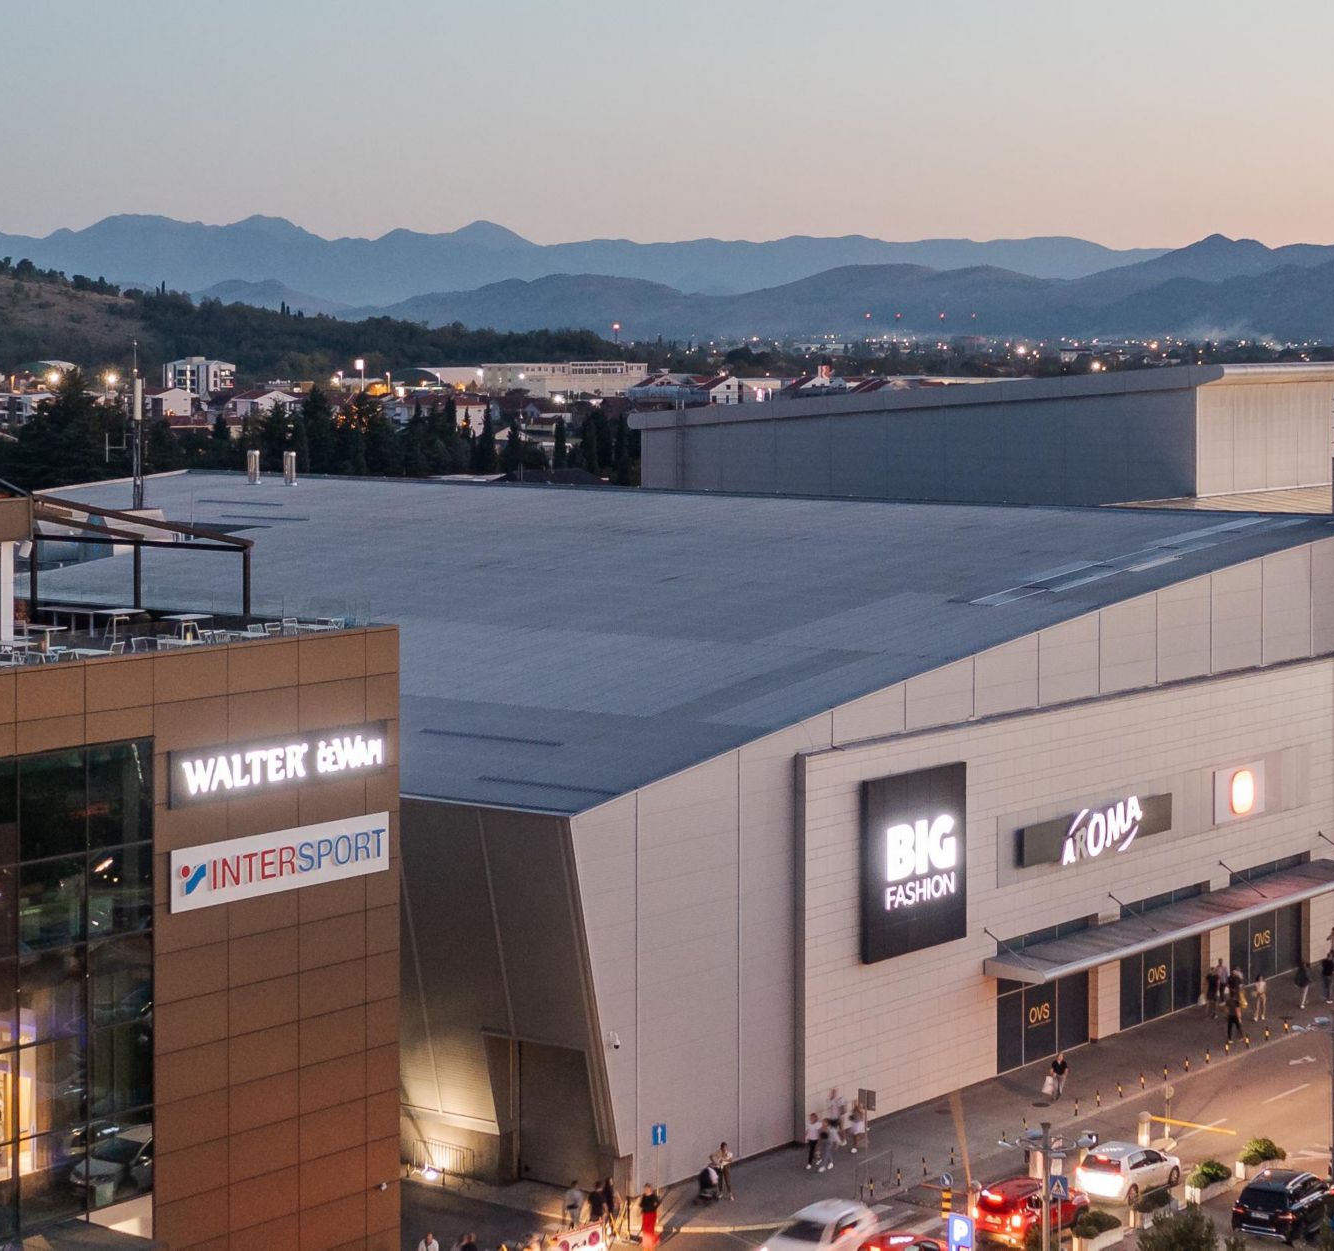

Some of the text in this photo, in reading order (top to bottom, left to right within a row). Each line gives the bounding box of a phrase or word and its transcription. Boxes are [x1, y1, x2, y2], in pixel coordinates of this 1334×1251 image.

[181, 742, 309, 795] WALTER
[886, 814, 956, 881] BIG
[1062, 795, 1143, 866] AROMA
[212, 828, 386, 890] INTERSPORT
[885, 871, 956, 911] FASHION
[1254, 930, 1271, 948] OVS
[1147, 964, 1167, 983] OVS
[1029, 1002, 1050, 1023] OVS
[953, 1218, 969, 1242] P
